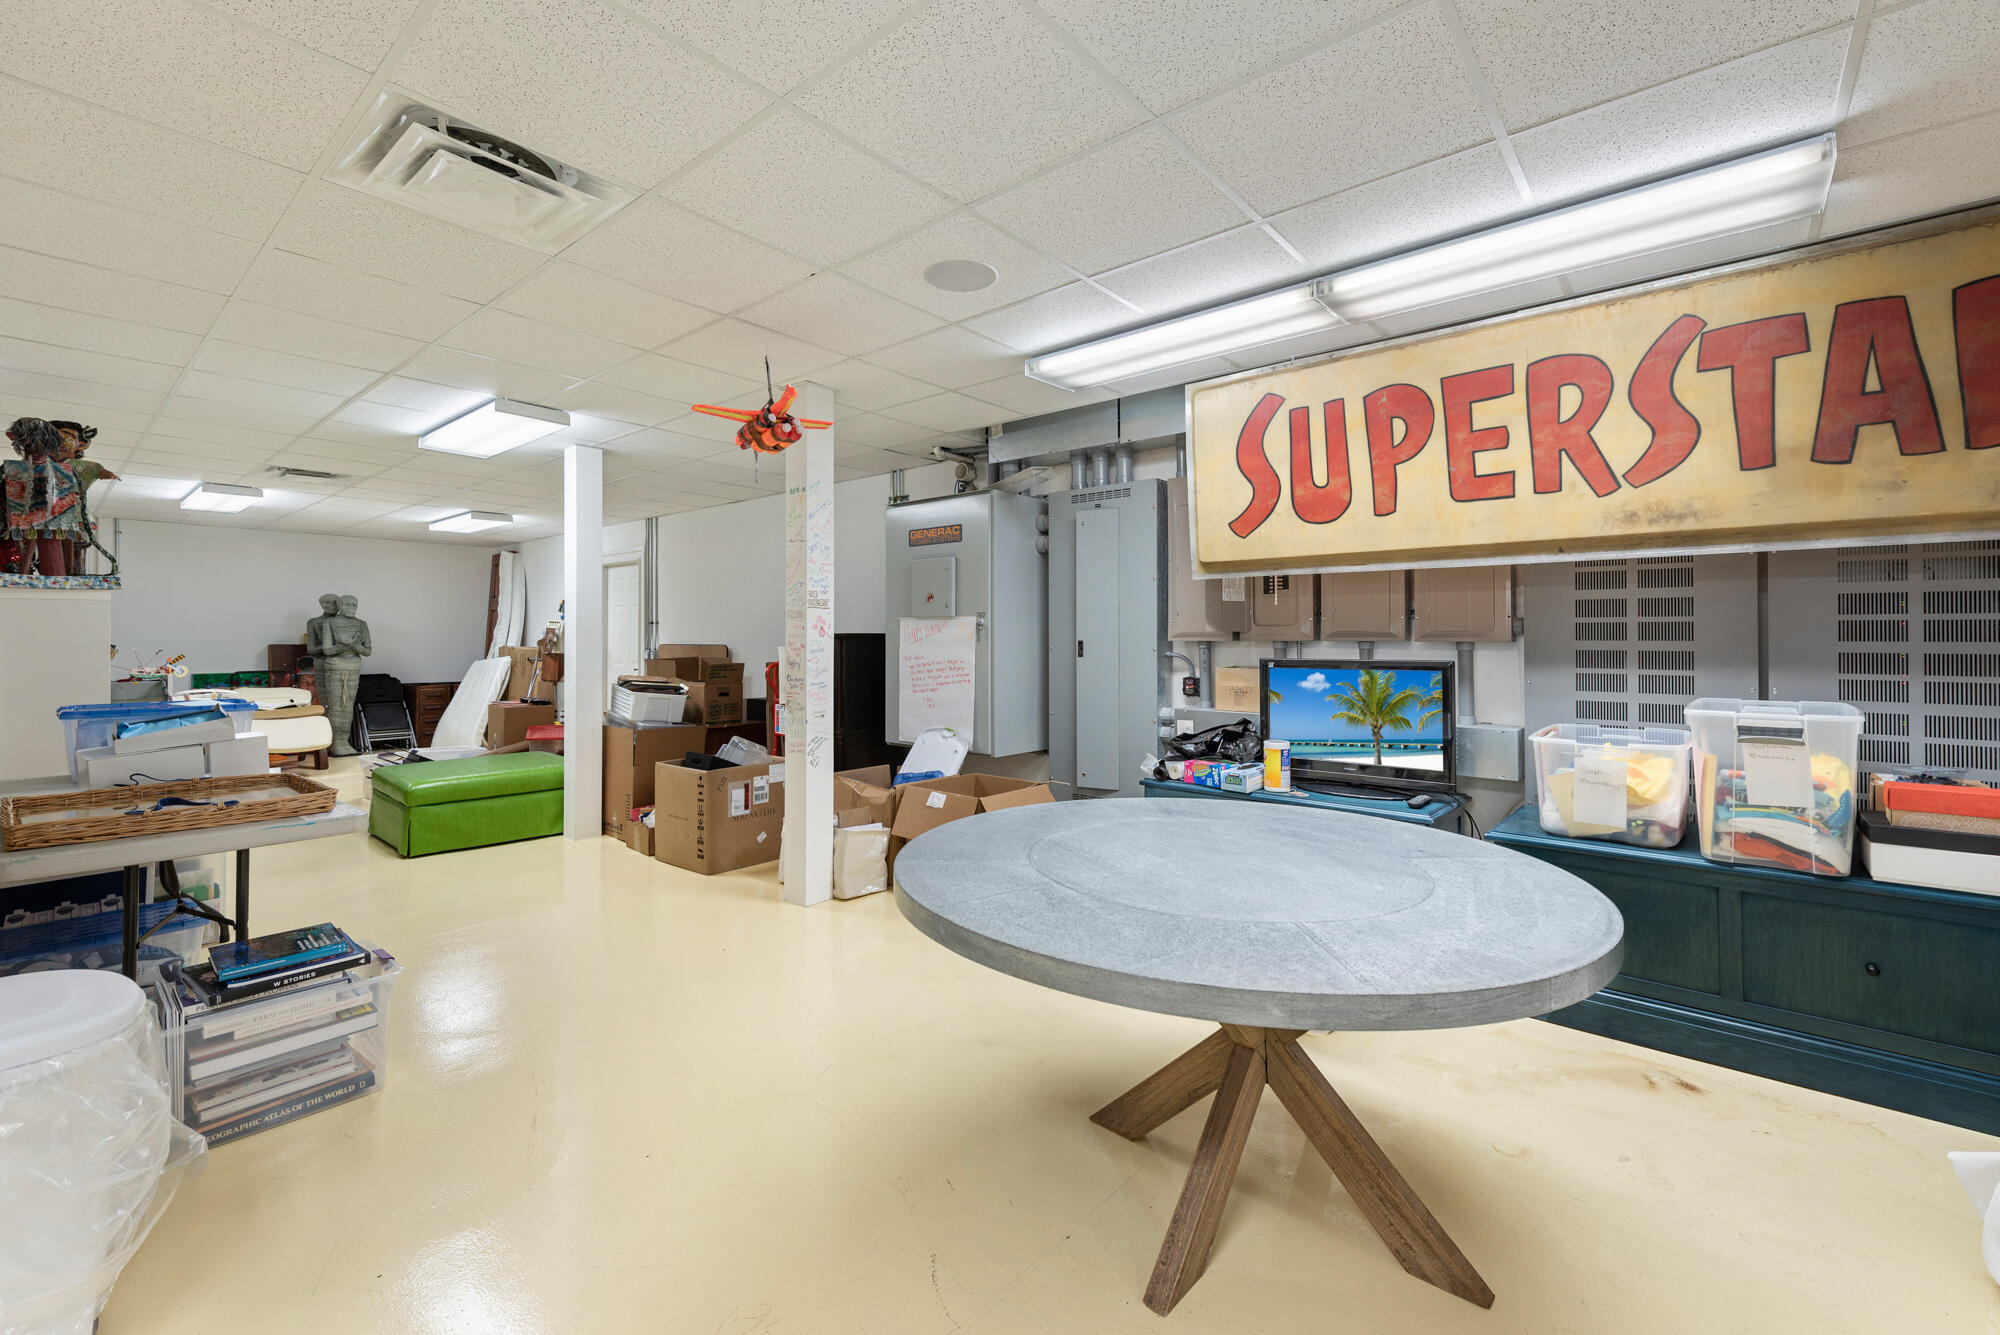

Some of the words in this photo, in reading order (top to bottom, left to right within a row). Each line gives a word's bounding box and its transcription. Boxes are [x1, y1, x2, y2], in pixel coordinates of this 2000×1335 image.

[909, 525, 961, 539] GENERAC
[283, 972, 316, 985] STORIES
[204, 1118, 262, 1144] EOGRAPHIC
[263, 1107, 291, 1123] ATLAS
[291, 1102, 304, 1113] OF
[306, 1095, 323, 1108] THE
[325, 1084, 356, 1101] WORLD
